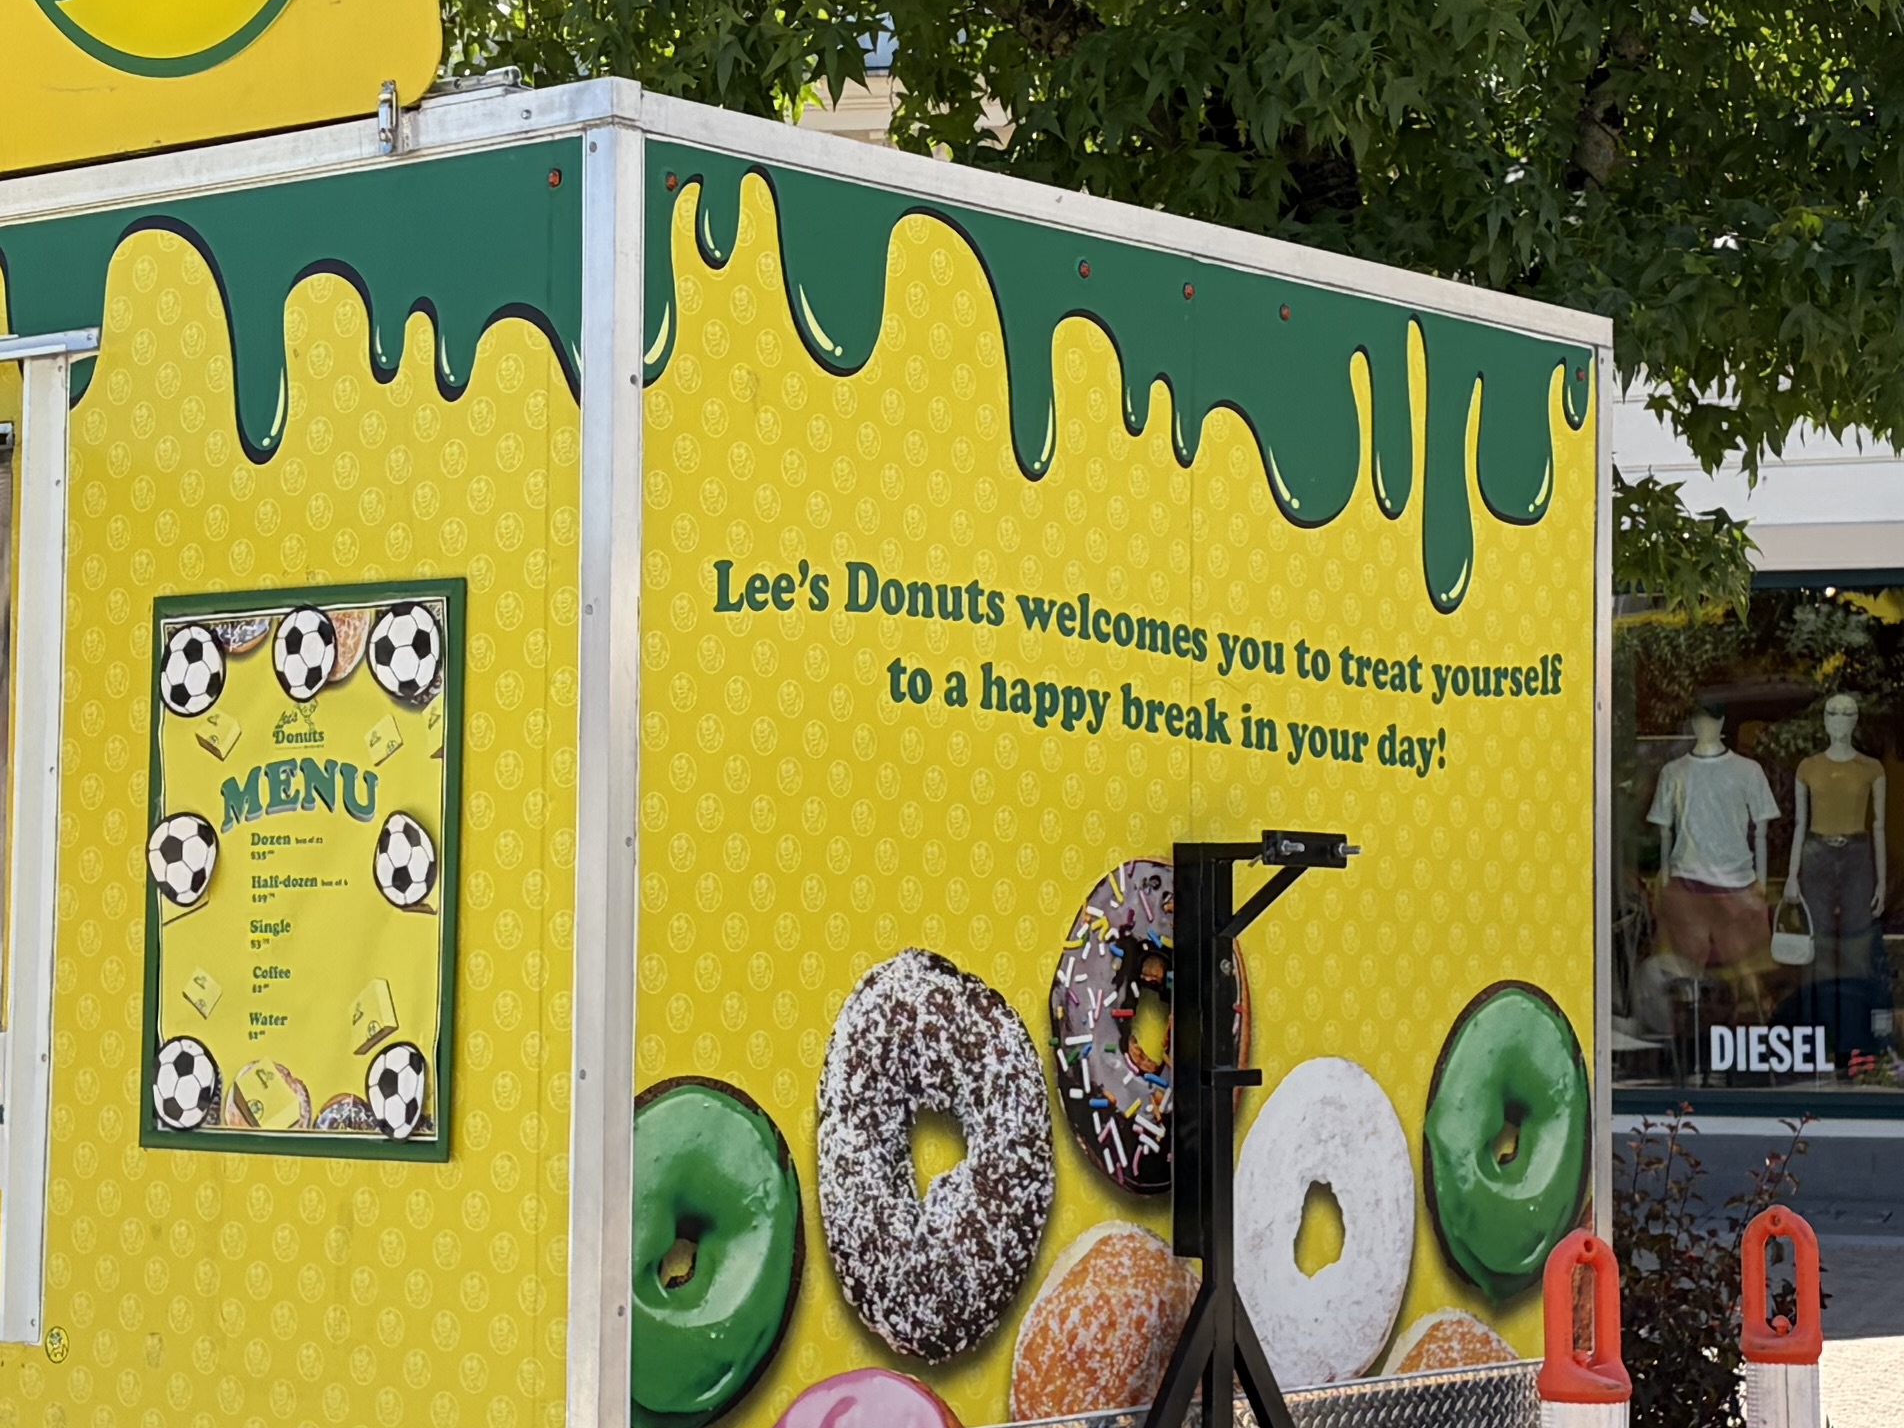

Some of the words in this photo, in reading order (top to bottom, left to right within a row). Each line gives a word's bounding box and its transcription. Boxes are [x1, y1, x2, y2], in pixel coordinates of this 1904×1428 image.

[712, 559, 830, 613] Lee's
[843, 561, 1005, 627] Donuts
[1016, 592, 1208, 662] welcomes
[1217, 632, 1286, 676] you
[1294, 639, 1331, 681] to
[1339, 646, 1423, 693] treat
[1431, 653, 1563, 704] yourself
[886, 657, 933, 704] to
[944, 670, 968, 707] a
[980, 662, 1111, 734] happy
[1120, 683, 1232, 745] break
[1240, 703, 1279, 752] in
[1287, 721, 1369, 765] your
[1377, 724, 1447, 777] day!
[273, 730, 324, 744] Donuts
[220, 757, 378, 833] MENU
[251, 832, 291, 846] Dozen
[251, 875, 318, 889] Half-dozen
[250, 919, 291, 937] Single
[252, 966, 291, 979] Coffee
[249, 1012, 288, 1026] Water
[1710, 1025, 1835, 1073] DIESEL
